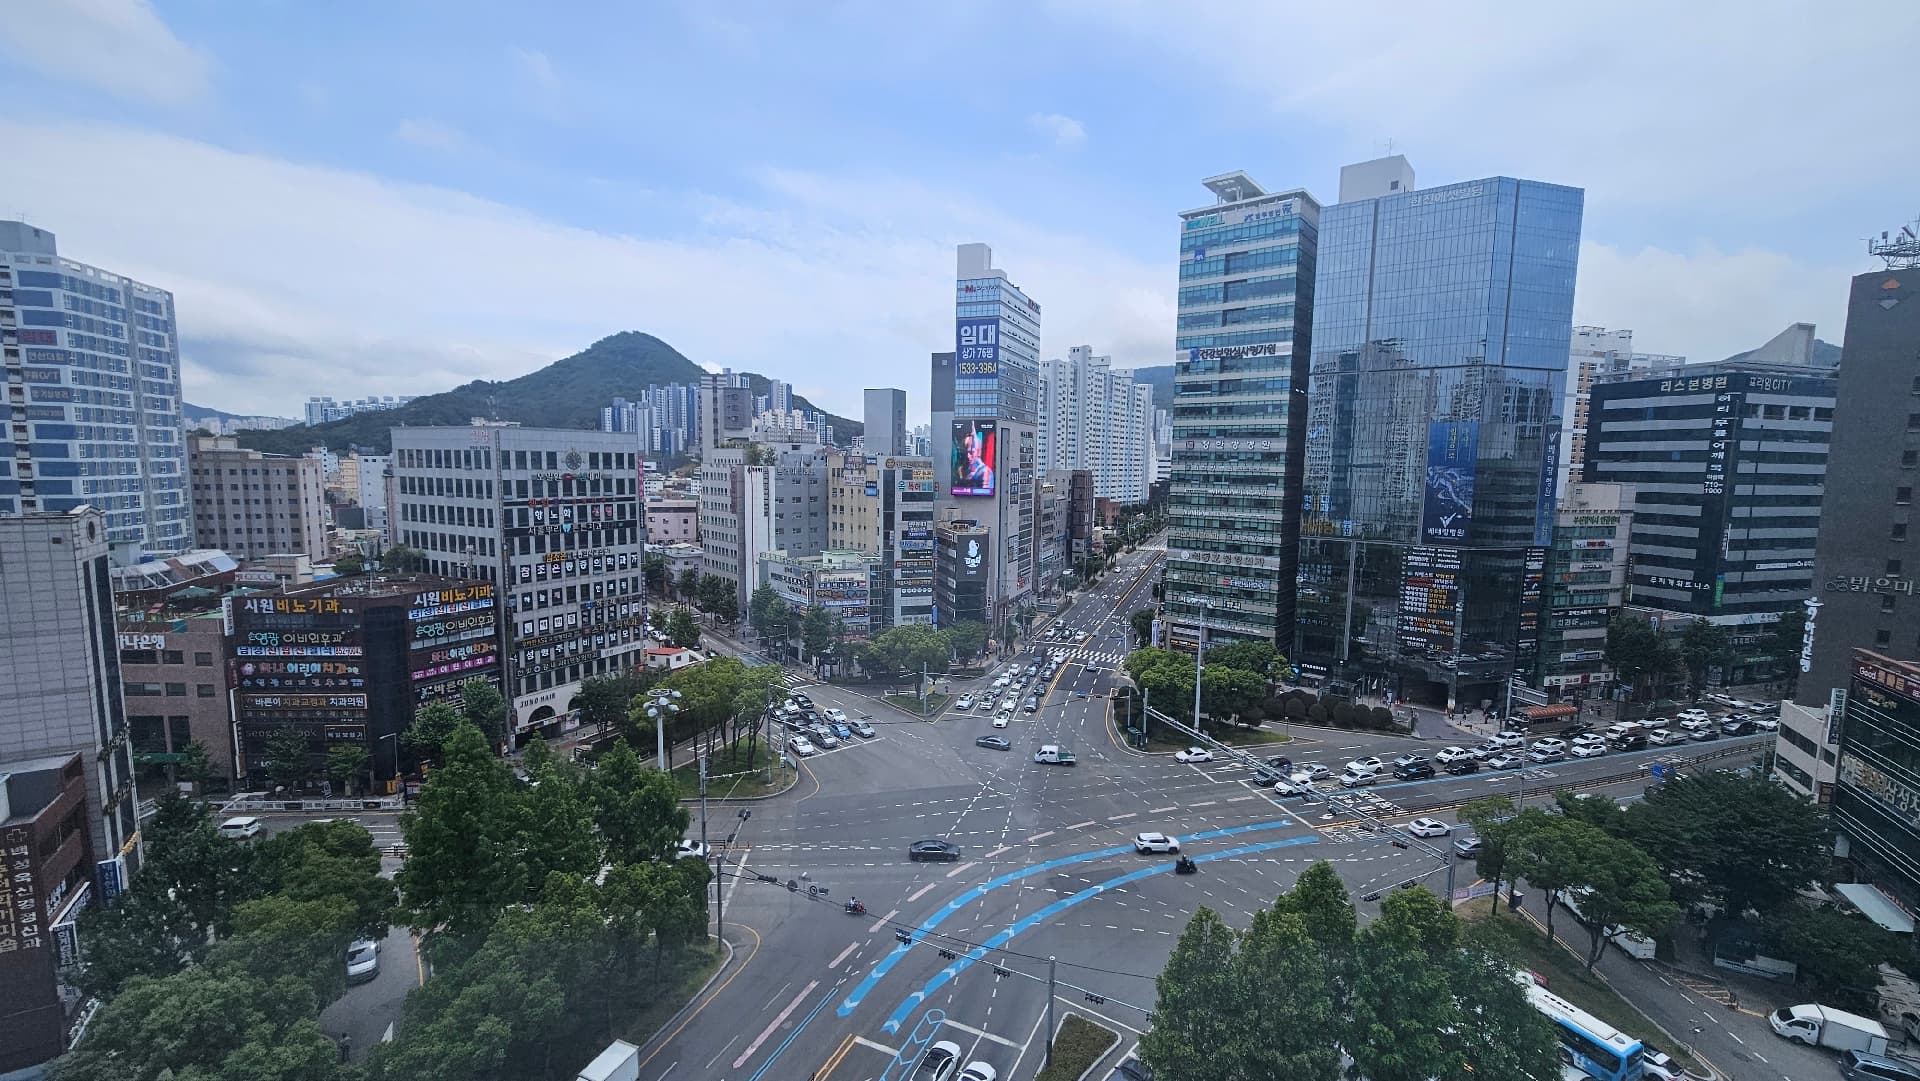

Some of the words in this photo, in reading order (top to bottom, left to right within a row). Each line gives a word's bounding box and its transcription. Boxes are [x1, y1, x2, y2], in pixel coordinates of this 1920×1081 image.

[961, 324, 996, 346] 임대
[962, 347, 976, 359] 상가
[977, 347, 994, 359] 76평
[959, 362, 997, 375] 1533-3964
[1660, 376, 1728, 392] 리스본병원
[413, 584, 491, 608] 시원비뇨기과
[244, 599, 339, 614] 시원비뇨기과
[282, 632, 343, 647] 이비인후과
[1860, 666, 1877, 680] Good
[520, 697, 539, 708] JUNO
[540, 692, 556, 702] HAIR
